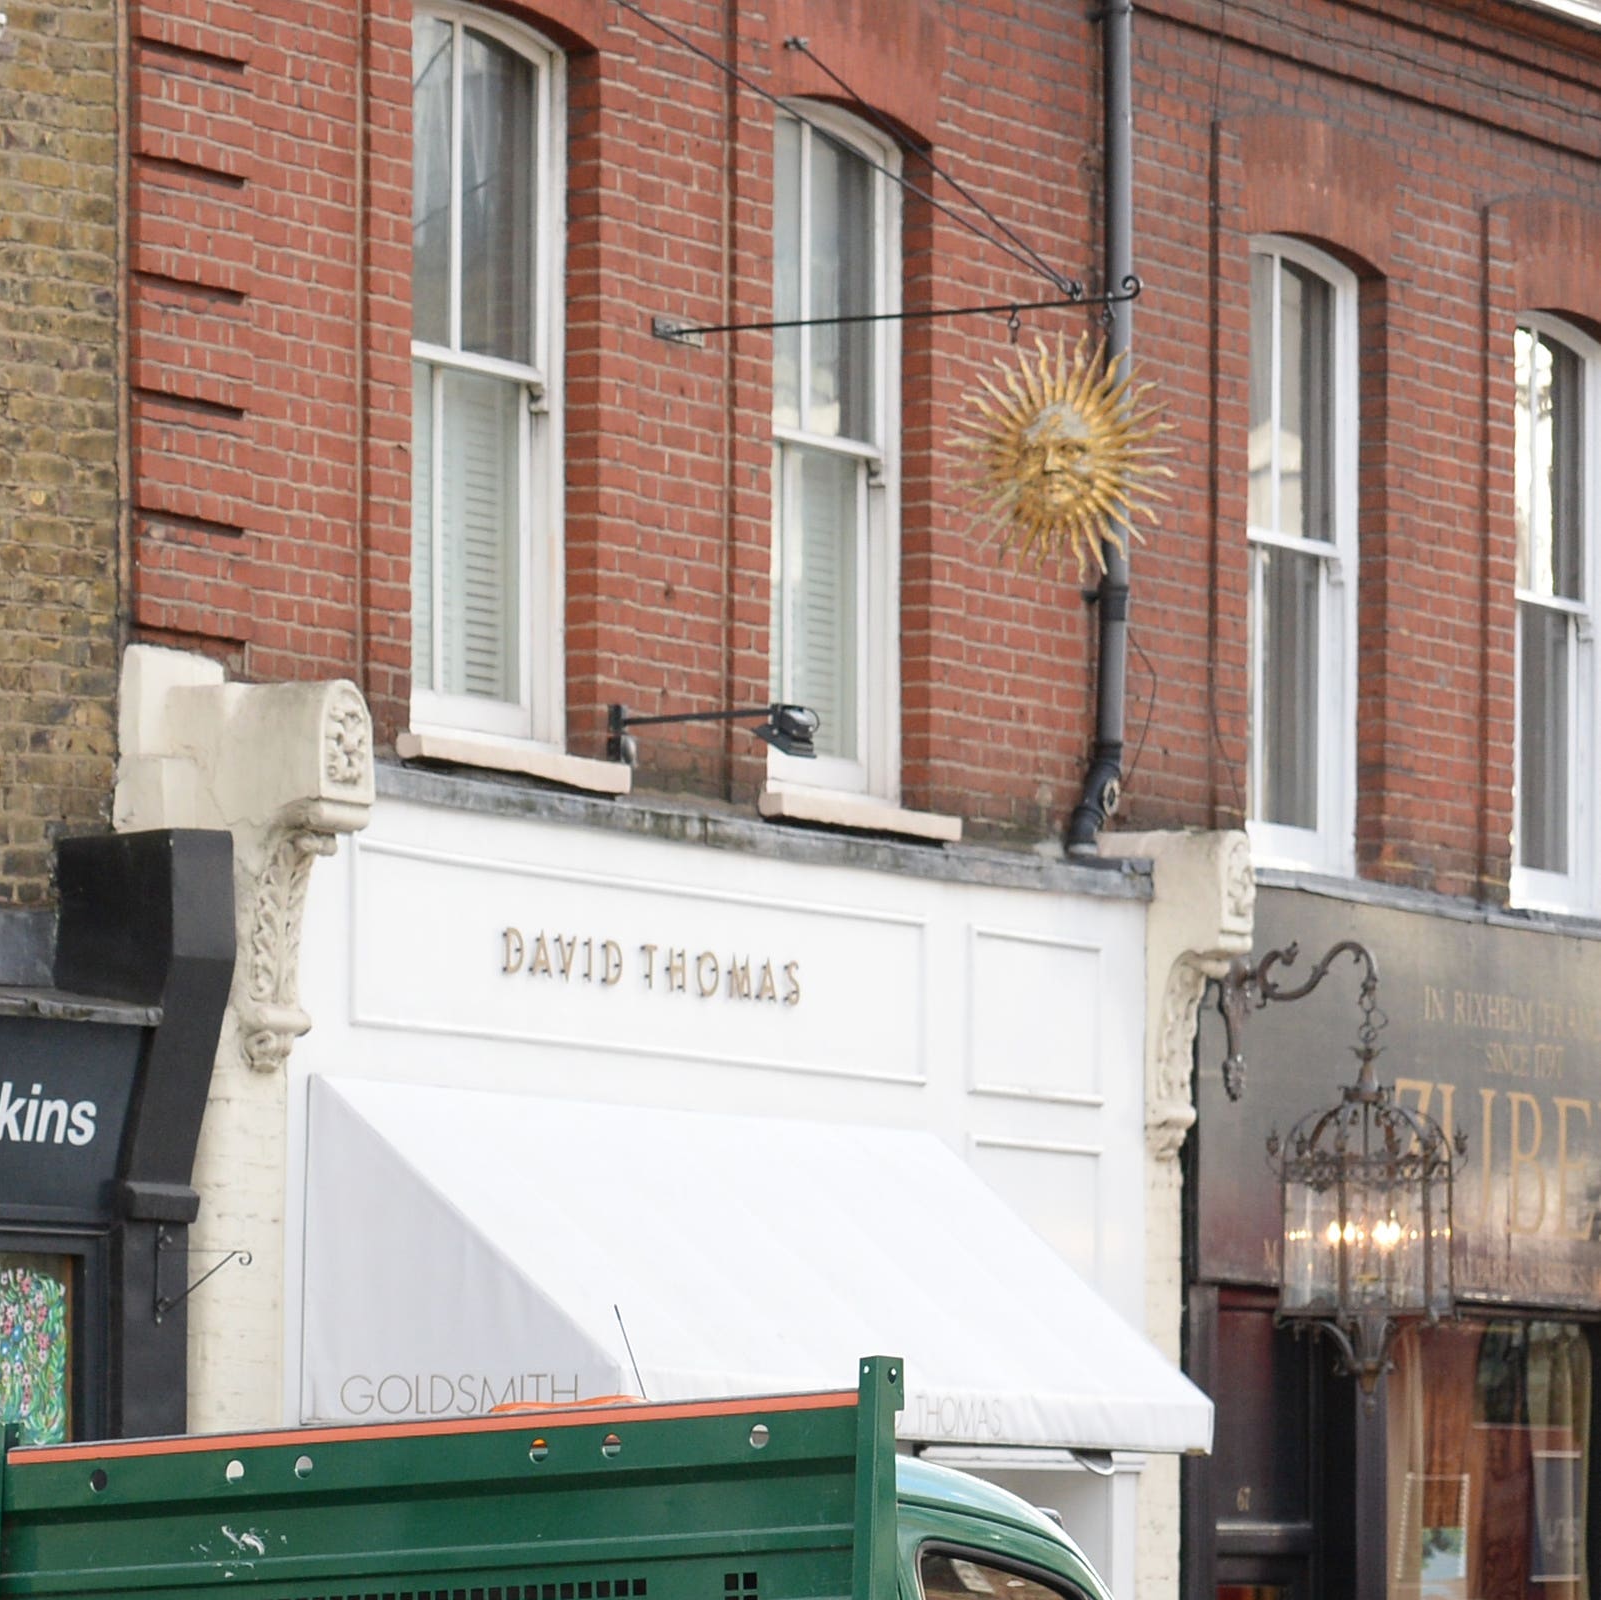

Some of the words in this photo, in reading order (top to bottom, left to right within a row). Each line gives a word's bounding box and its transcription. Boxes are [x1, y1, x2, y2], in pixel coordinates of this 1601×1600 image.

[502, 927, 623, 985] DAVID
[640, 944, 800, 1006] THOMAS
[1395, 1077, 1601, 1241] ZUBE
[341, 1374, 578, 1415] GOLDSMITH
